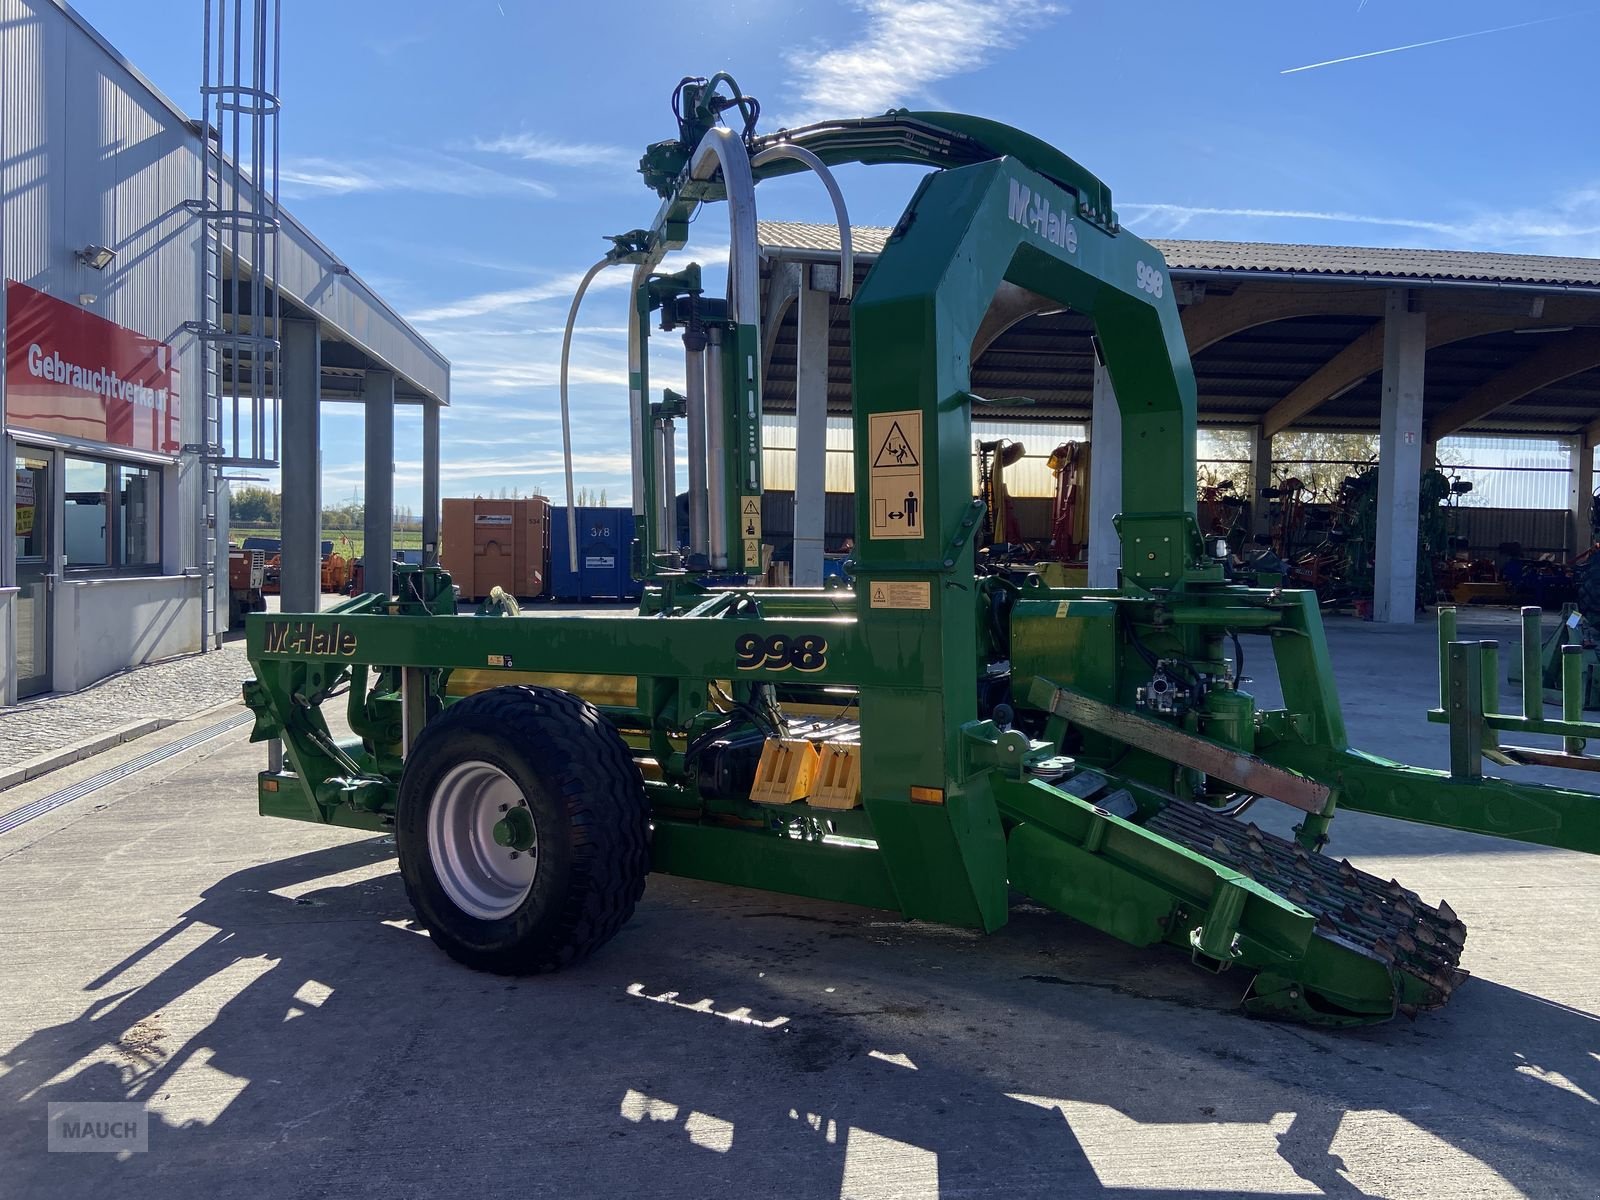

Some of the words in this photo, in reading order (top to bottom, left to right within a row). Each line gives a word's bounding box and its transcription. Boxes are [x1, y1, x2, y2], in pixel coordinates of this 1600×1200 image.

[1136, 260, 1163, 299] 998
[28, 343, 168, 413] Gebrauchtverkauf
[735, 633, 828, 672] 998
